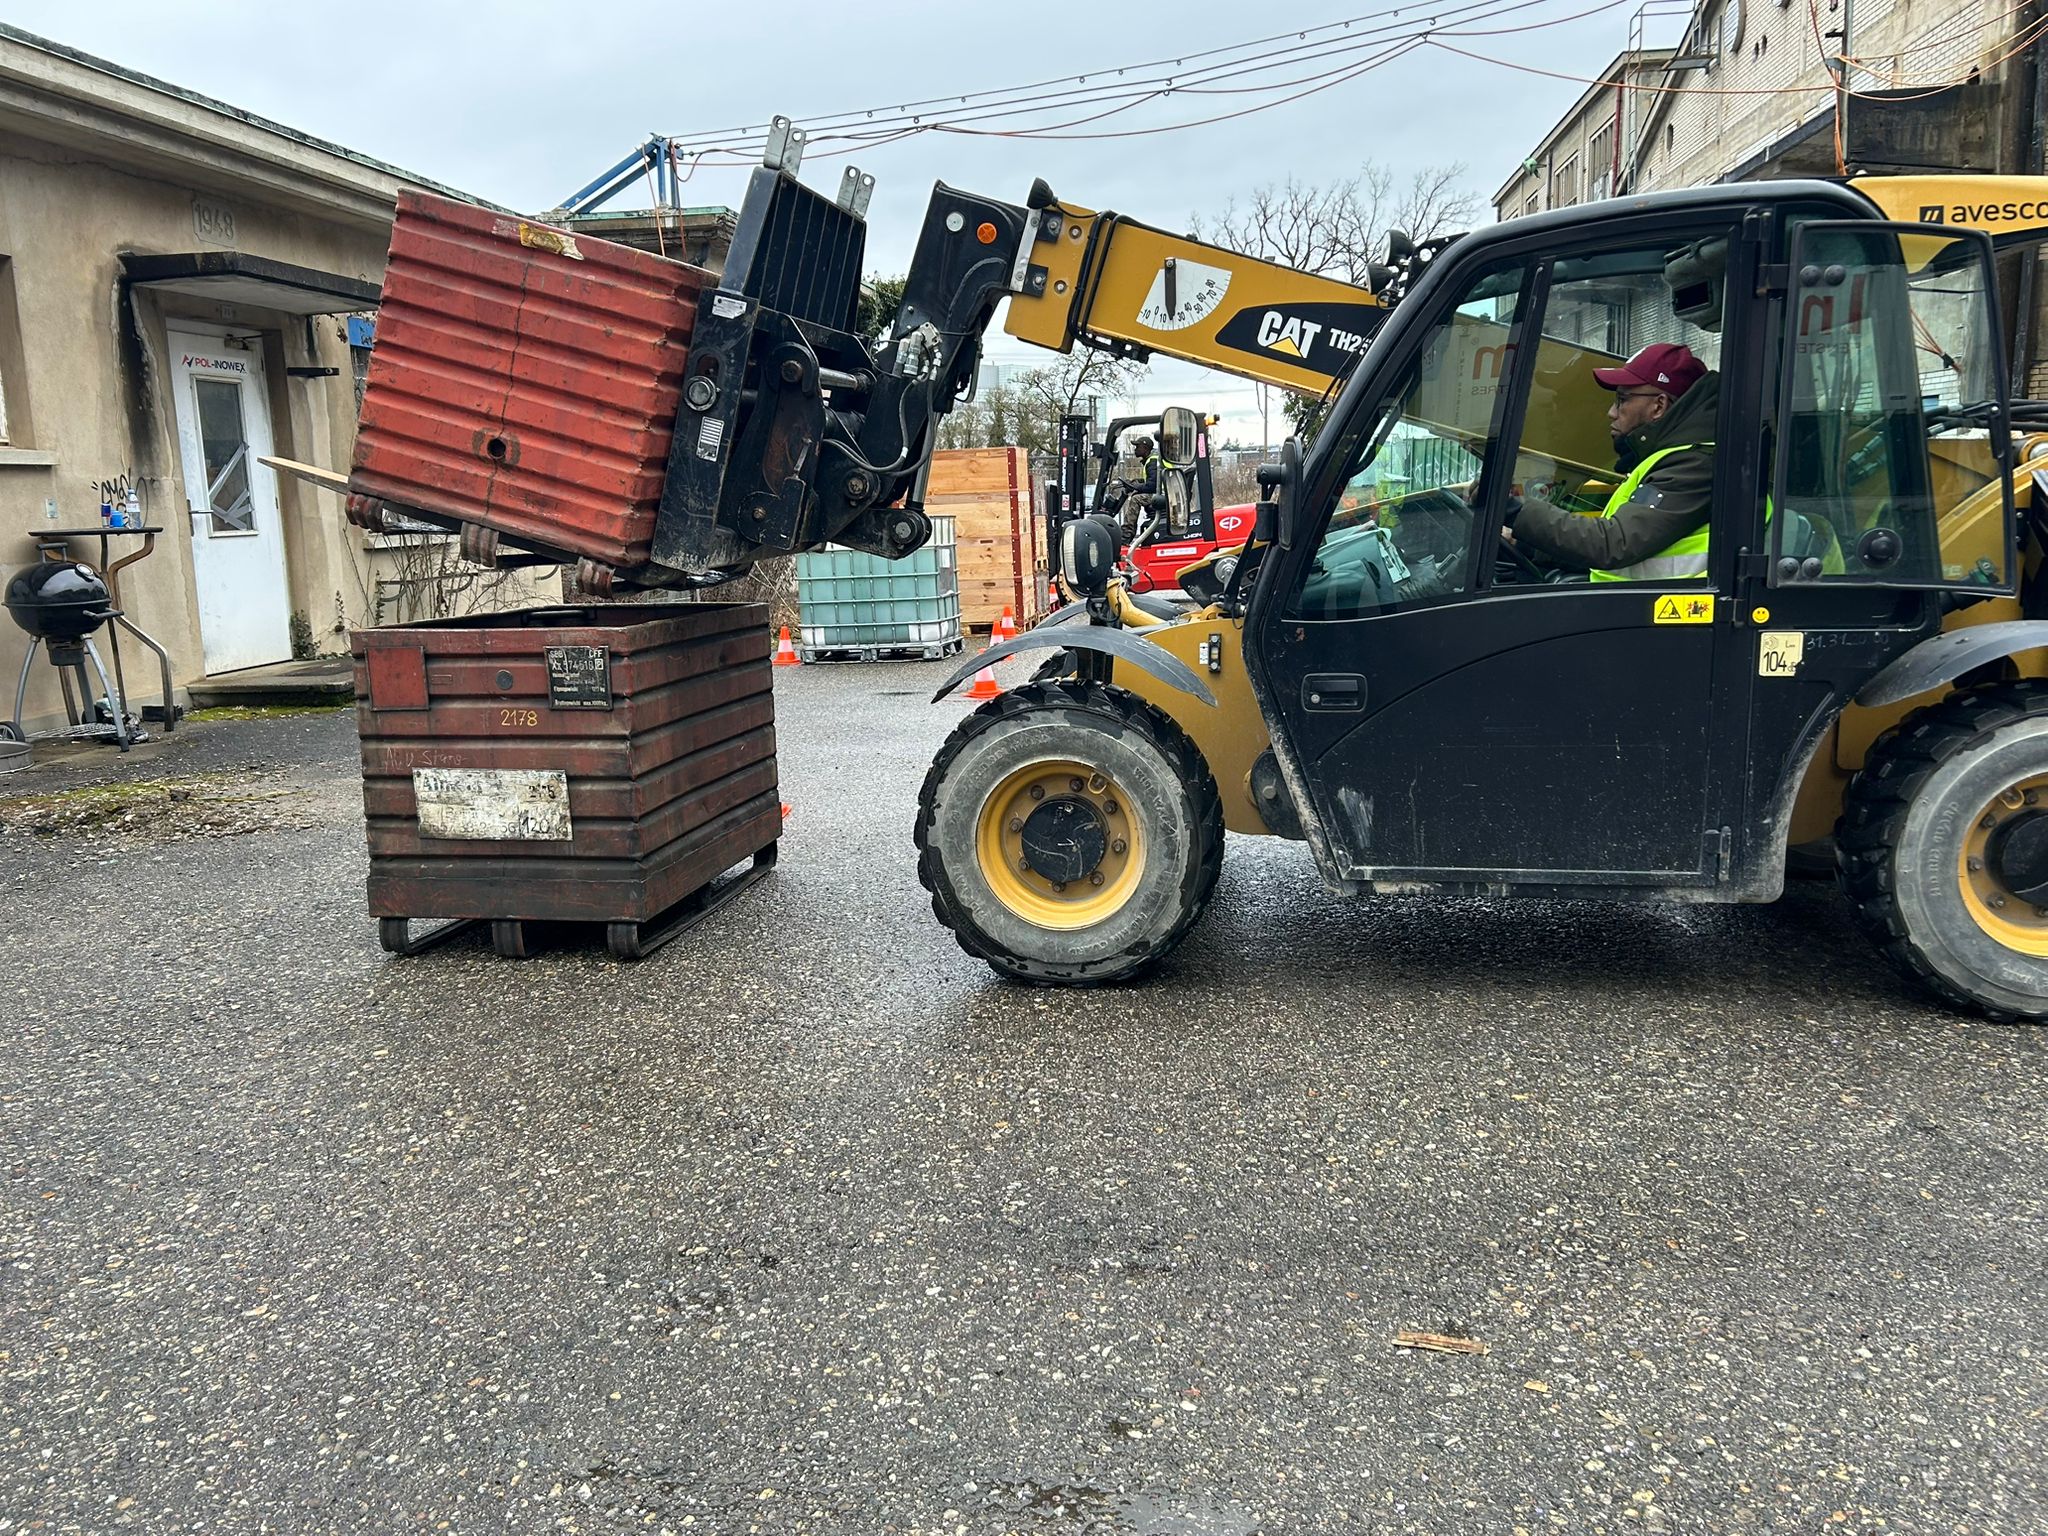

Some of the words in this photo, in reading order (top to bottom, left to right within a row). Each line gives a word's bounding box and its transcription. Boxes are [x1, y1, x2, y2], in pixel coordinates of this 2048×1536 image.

[1951, 202, 2048, 223] avesco
[195, 204, 234, 239] 1948
[1205, 279, 1216, 288] 80
[1206, 289, 1217, 299] 70
[1154, 305, 1160, 316] 0
[1184, 302, 1193, 312] 40
[1193, 303, 1203, 314] 50
[1159, 313, 1167, 323] 10
[1177, 311, 1186, 322] 30
[1257, 310, 1323, 359] CAT
[194, 357, 247, 373] POL-INOWEX
[1219, 516, 1243, 531] EP
[588, 649, 603, 658] CFF
[1763, 651, 1787, 673] 104
[500, 709, 538, 727] 2178
